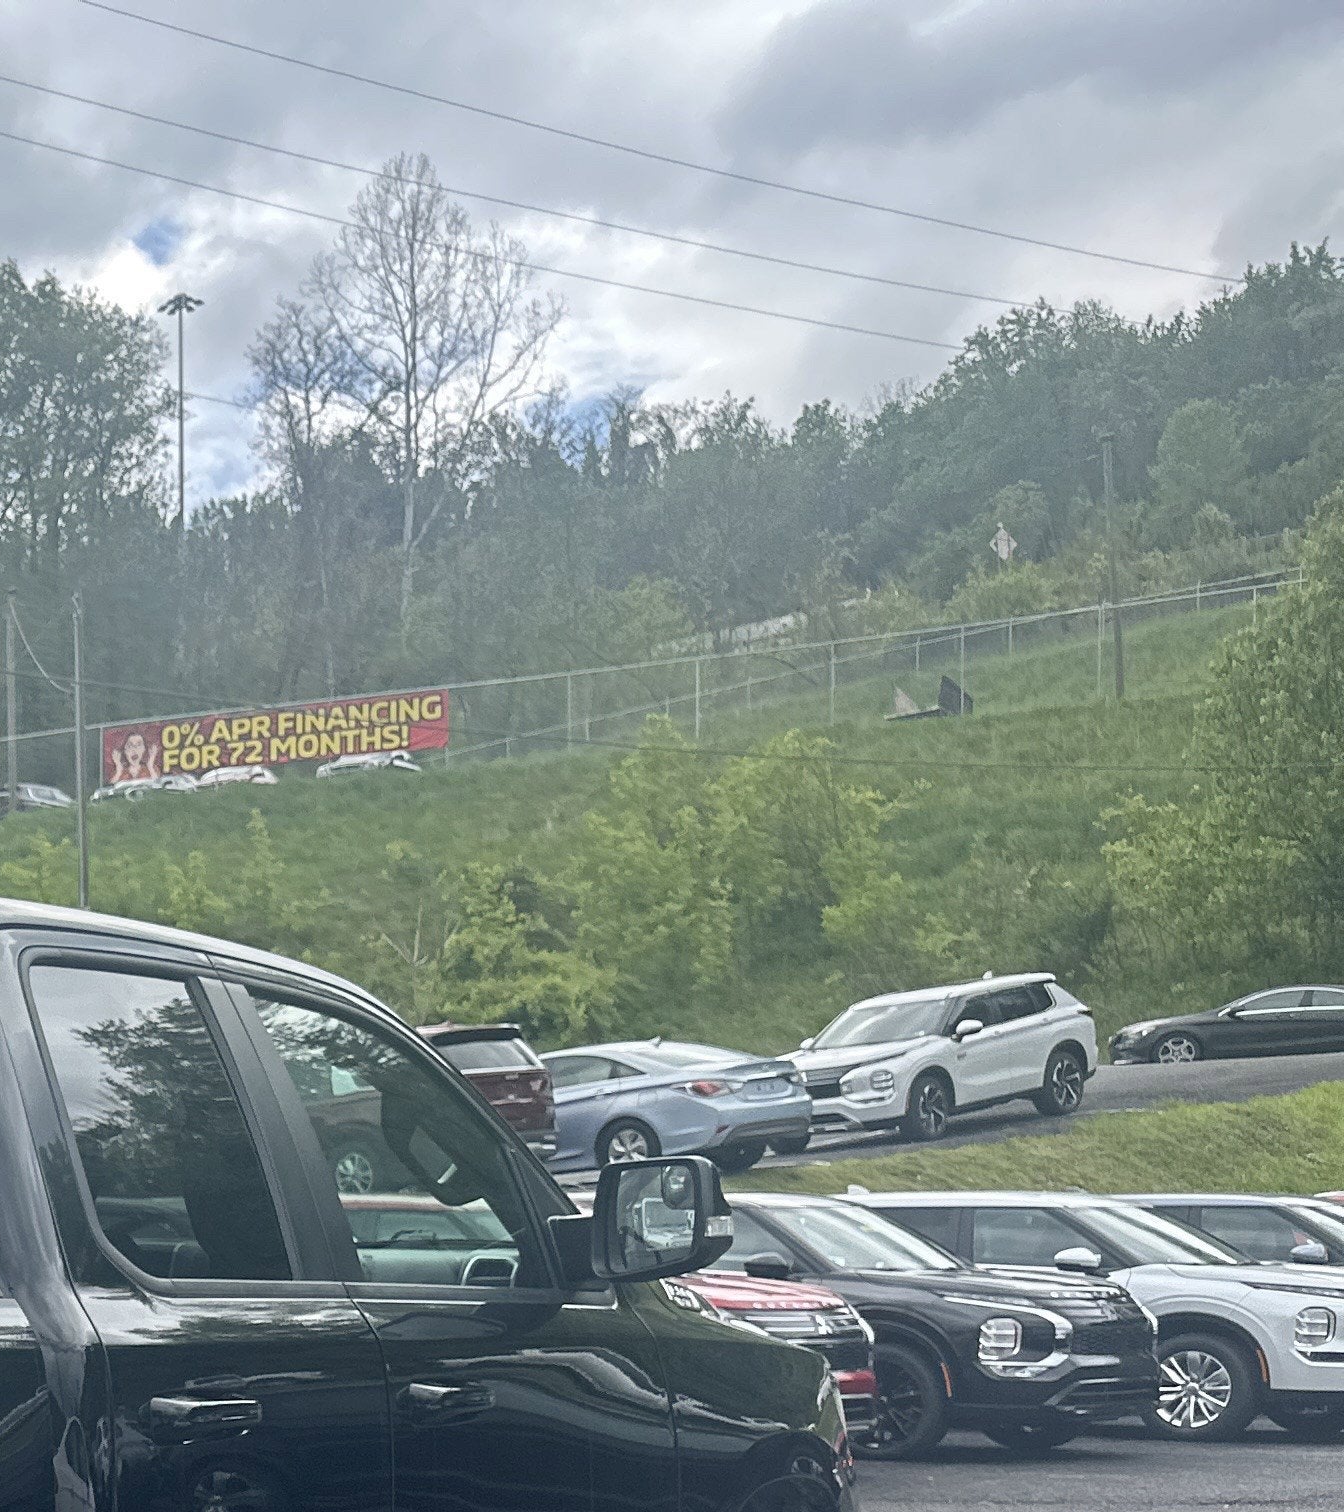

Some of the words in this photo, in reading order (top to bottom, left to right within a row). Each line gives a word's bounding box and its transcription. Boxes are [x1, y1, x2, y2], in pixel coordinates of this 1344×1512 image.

[163, 722, 204, 749] 0%
[210, 715, 270, 743] APR
[278, 695, 442, 736] FINANCING
[163, 744, 220, 774] FOR
[229, 741, 263, 766] 72
[270, 724, 410, 762] MONTHS!
